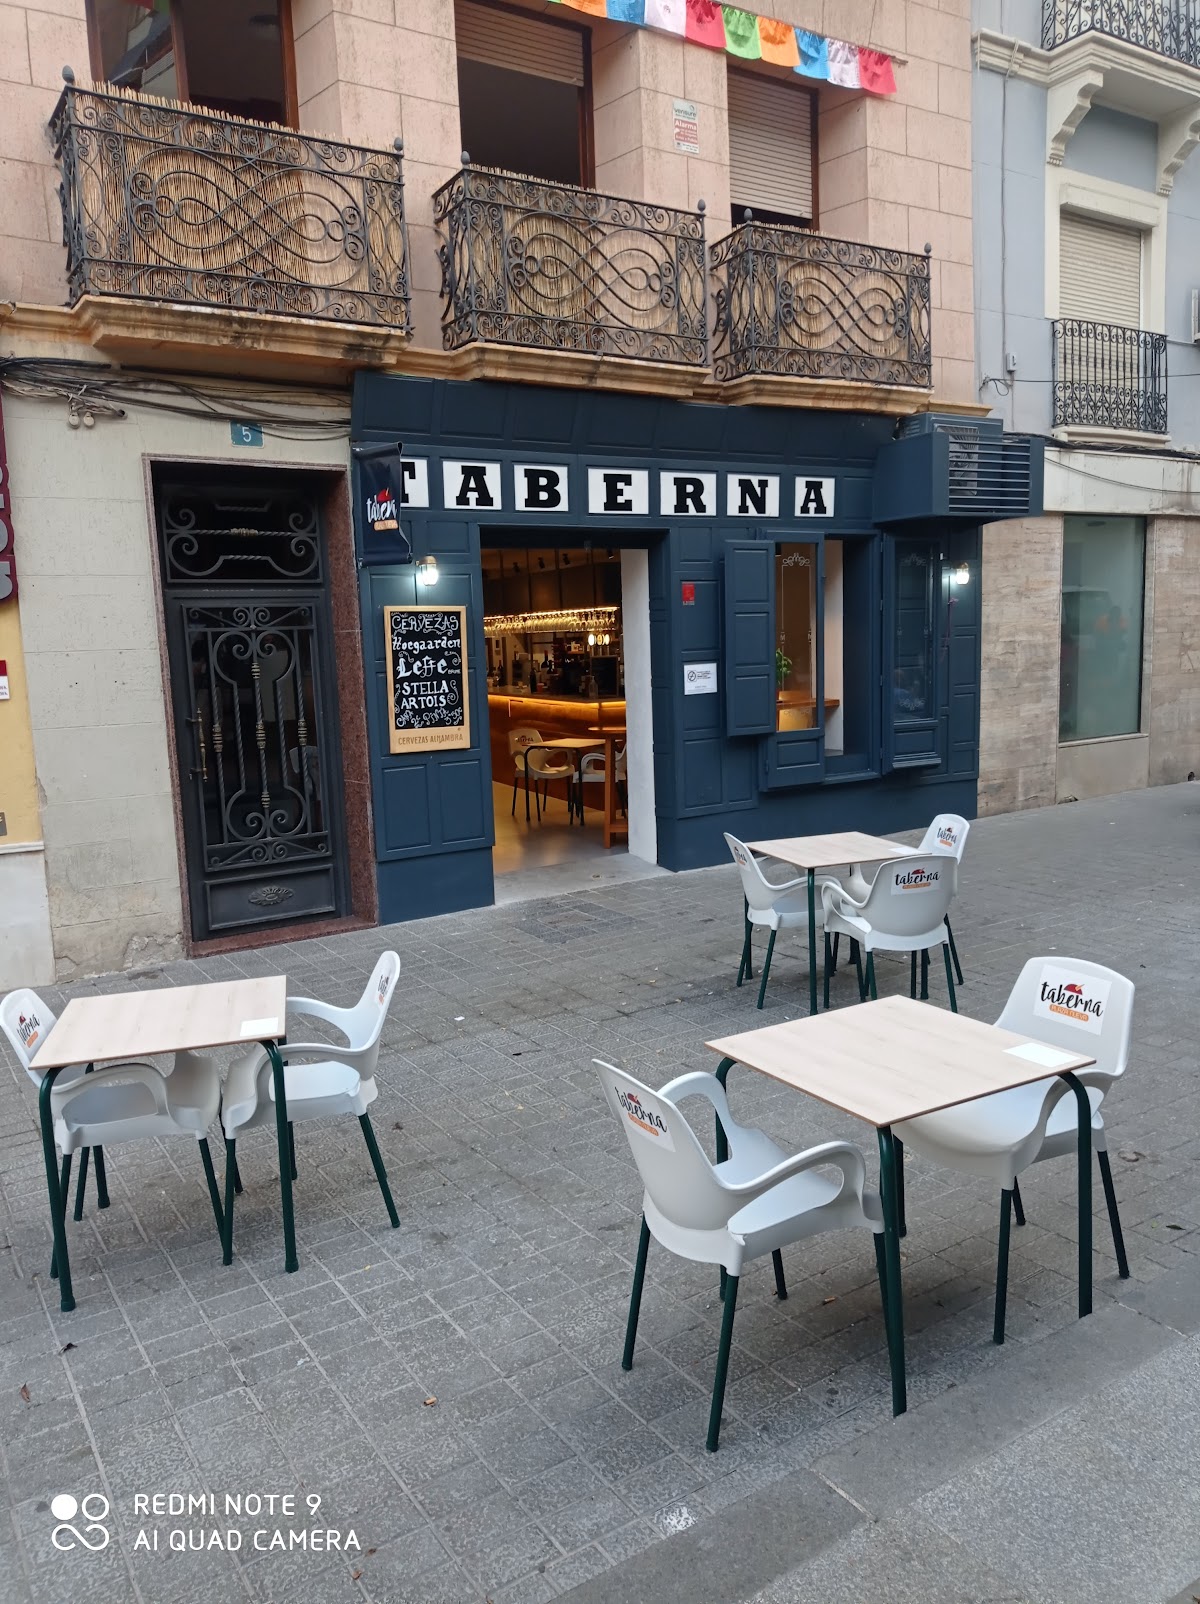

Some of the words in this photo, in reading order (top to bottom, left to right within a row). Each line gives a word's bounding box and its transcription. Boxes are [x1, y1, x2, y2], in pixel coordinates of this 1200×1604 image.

[675, 120, 697, 131] Alarma
[242, 426, 251, 442] 5
[391, 615, 459, 632] CERVEZAS
[392, 636, 462, 654] Hoegaarden
[396, 655, 448, 679] Leffe
[402, 680, 449, 696] STELLA
[401, 695, 447, 709] ARTOIS
[398, 735, 429, 746] CERVEZAS
[430, 733, 464, 744] ALHAMBRA
[895, 871, 941, 886] taberna
[1040, 981, 1104, 1017] taberna
[614, 1086, 667, 1133] taberna
